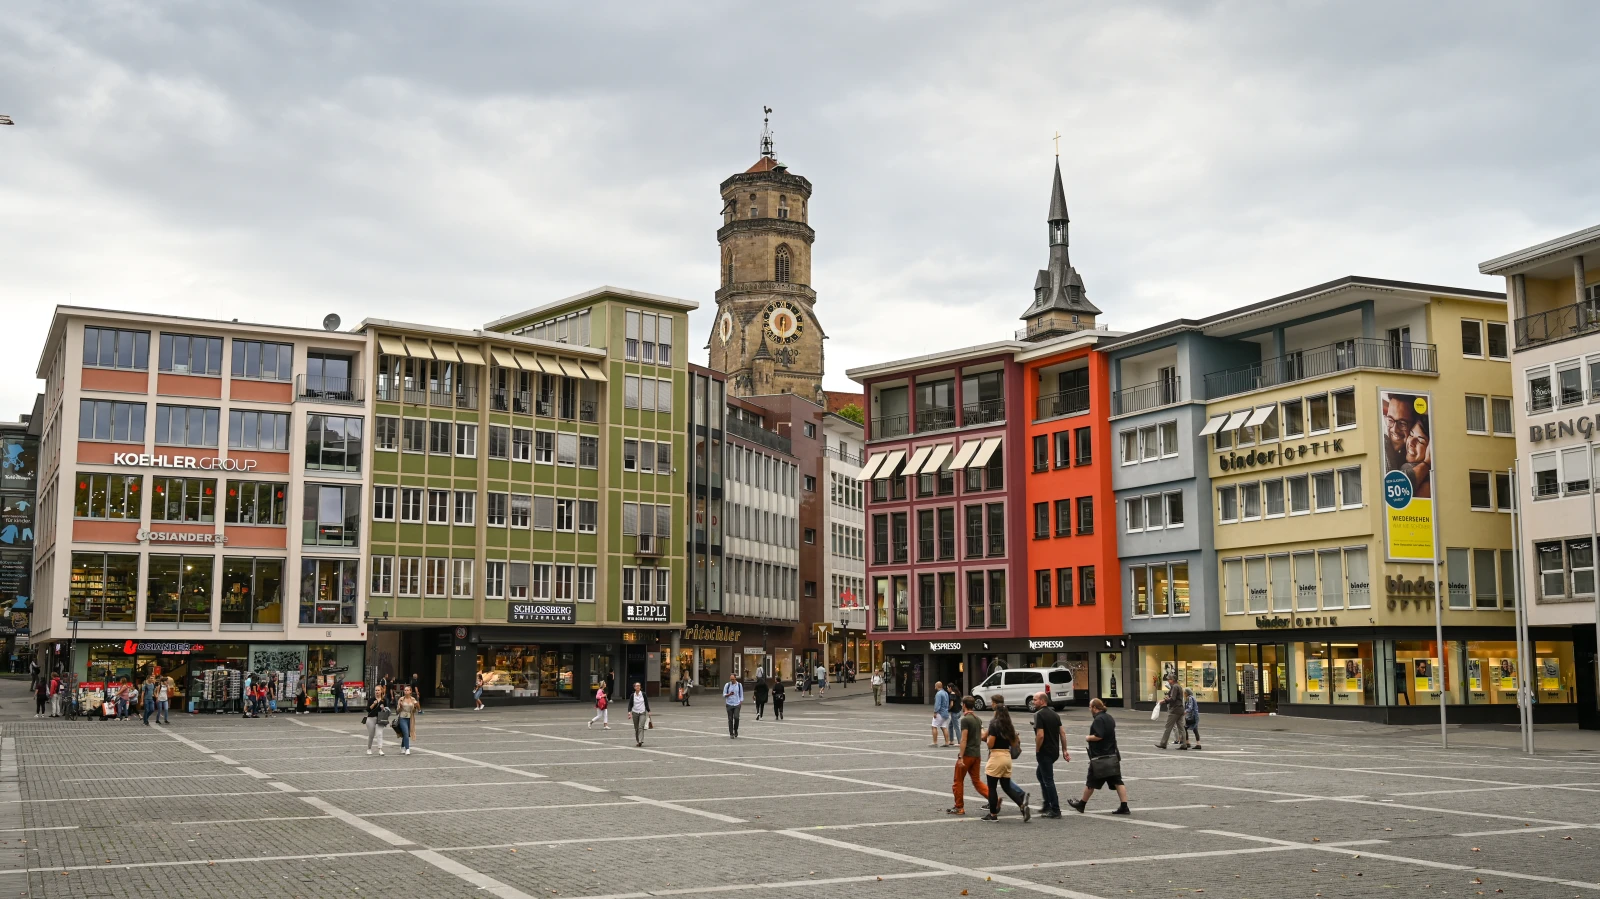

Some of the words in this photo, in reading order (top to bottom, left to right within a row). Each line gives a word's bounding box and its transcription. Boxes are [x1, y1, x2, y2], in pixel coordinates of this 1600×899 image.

[1219, 448, 1276, 471] binder
[1284, 438, 1344, 461] OPTIK
[113, 452, 257, 472] KOEHLER.GROUP
[1387, 484, 1410, 498] 50%
[1392, 515, 1430, 523] WIEDERSEHEN
[149, 531, 229, 544] OSIANDER.de
[514, 605, 572, 614] SCHLOSSBERG
[636, 605, 667, 617] EPPLI
[1256, 615, 1290, 629] binder
[1296, 616, 1338, 628] OPTIK
[137, 643, 205, 651] OSIANDER.de
[929, 642, 962, 652] NESPRESSO
[1029, 640, 1064, 650] NESPRESSO
